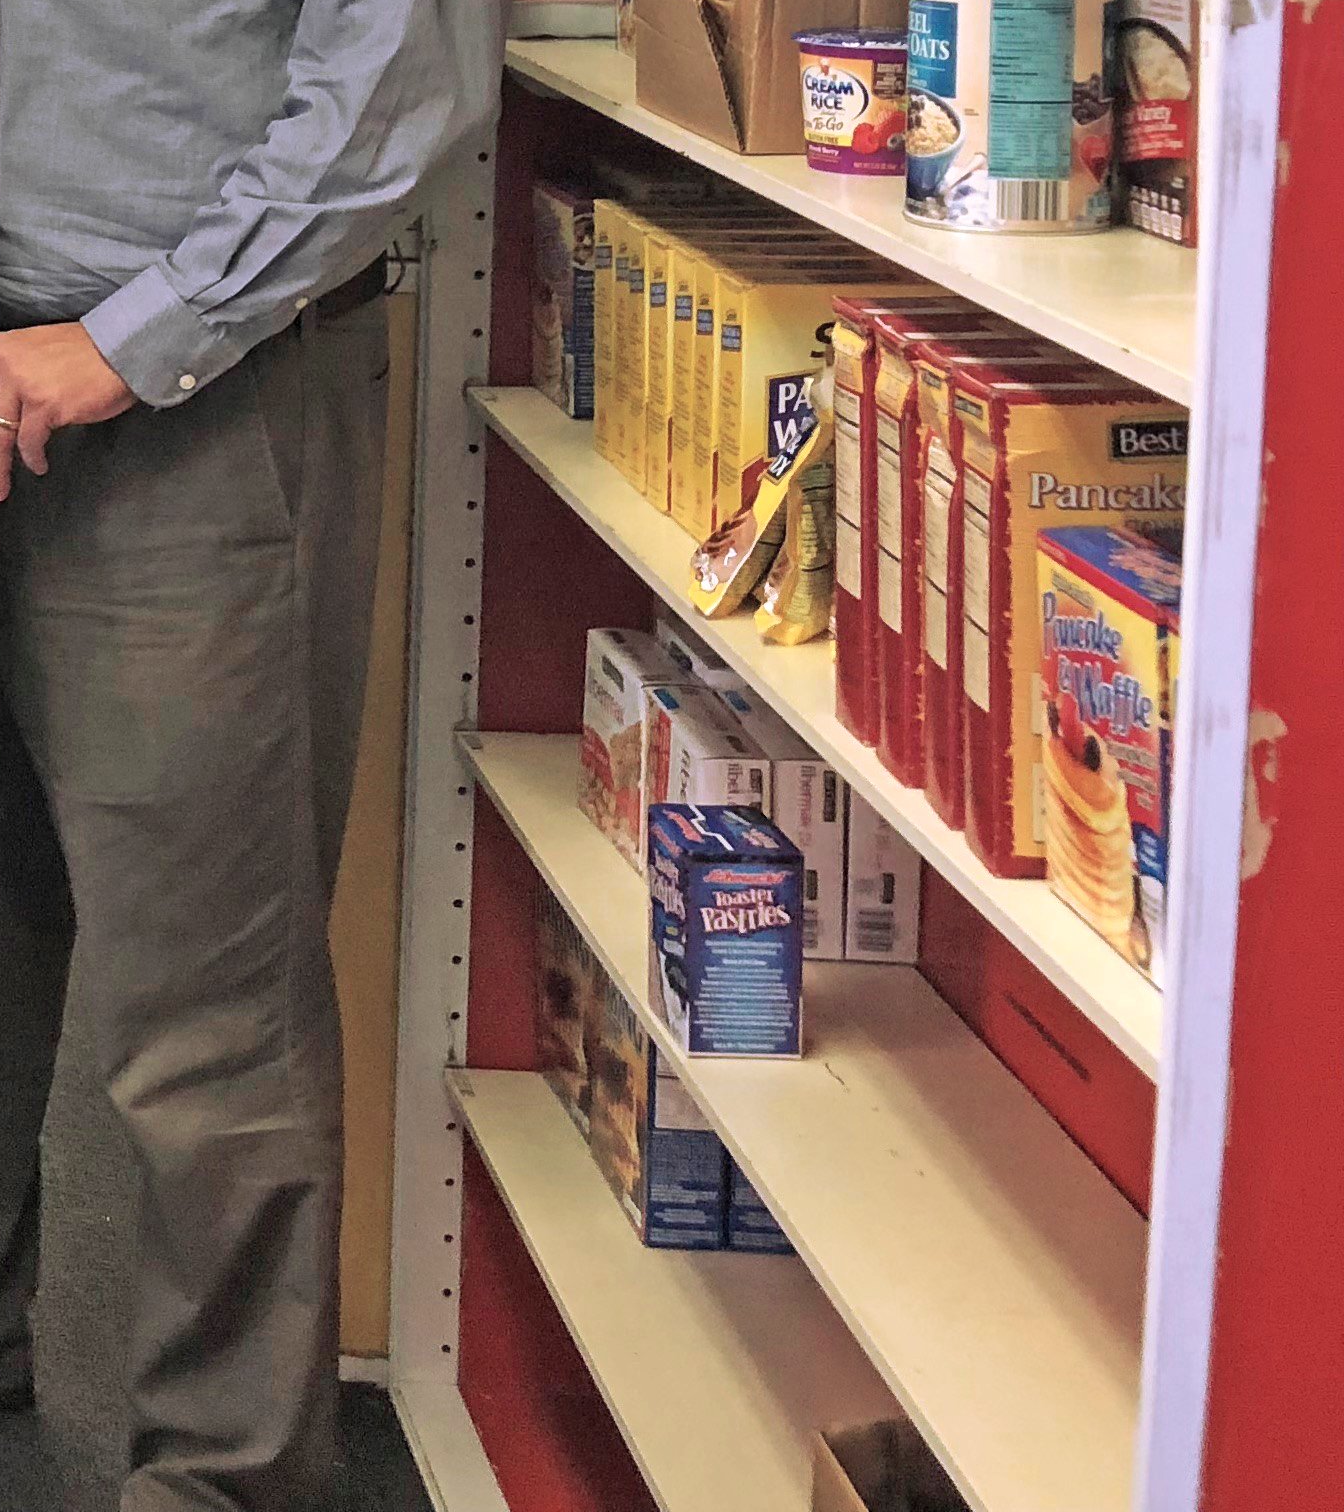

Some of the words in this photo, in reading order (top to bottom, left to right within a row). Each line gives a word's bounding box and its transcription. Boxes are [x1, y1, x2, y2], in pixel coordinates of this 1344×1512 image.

[912, 33, 951, 62] OATS
[804, 74, 855, 97] CREAM
[810, 92, 844, 111] RICE
[1118, 427, 1188, 454] Best
[1041, 591, 1123, 661] Pancake
[1073, 659, 1154, 736] Waffle
[714, 888, 775, 907] Toaster
[699, 903, 792, 934] Pastries
